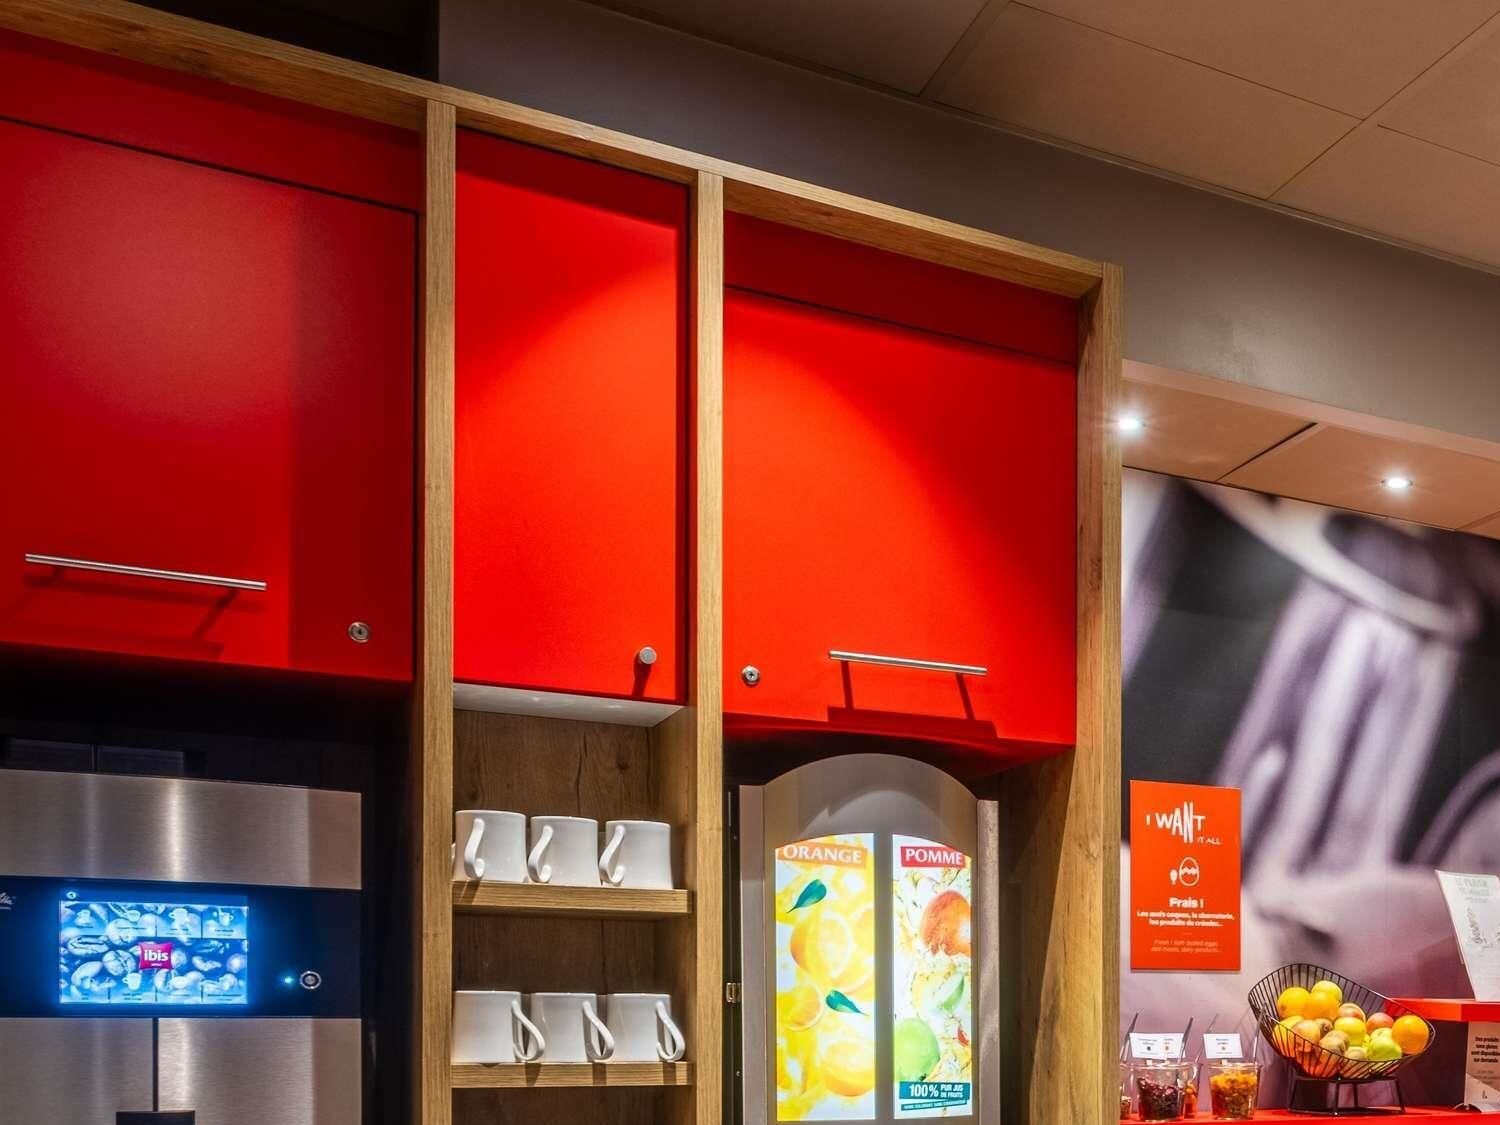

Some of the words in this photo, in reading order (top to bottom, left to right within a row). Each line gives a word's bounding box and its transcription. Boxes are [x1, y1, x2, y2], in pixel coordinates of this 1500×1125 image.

[1155, 801, 1206, 844] WANT
[1206, 837, 1221, 845] ALL
[783, 845, 862, 864] ORANGE
[905, 847, 963, 865] POMME
[1169, 897, 1198, 909] Frais
[144, 949, 169, 962] ibis
